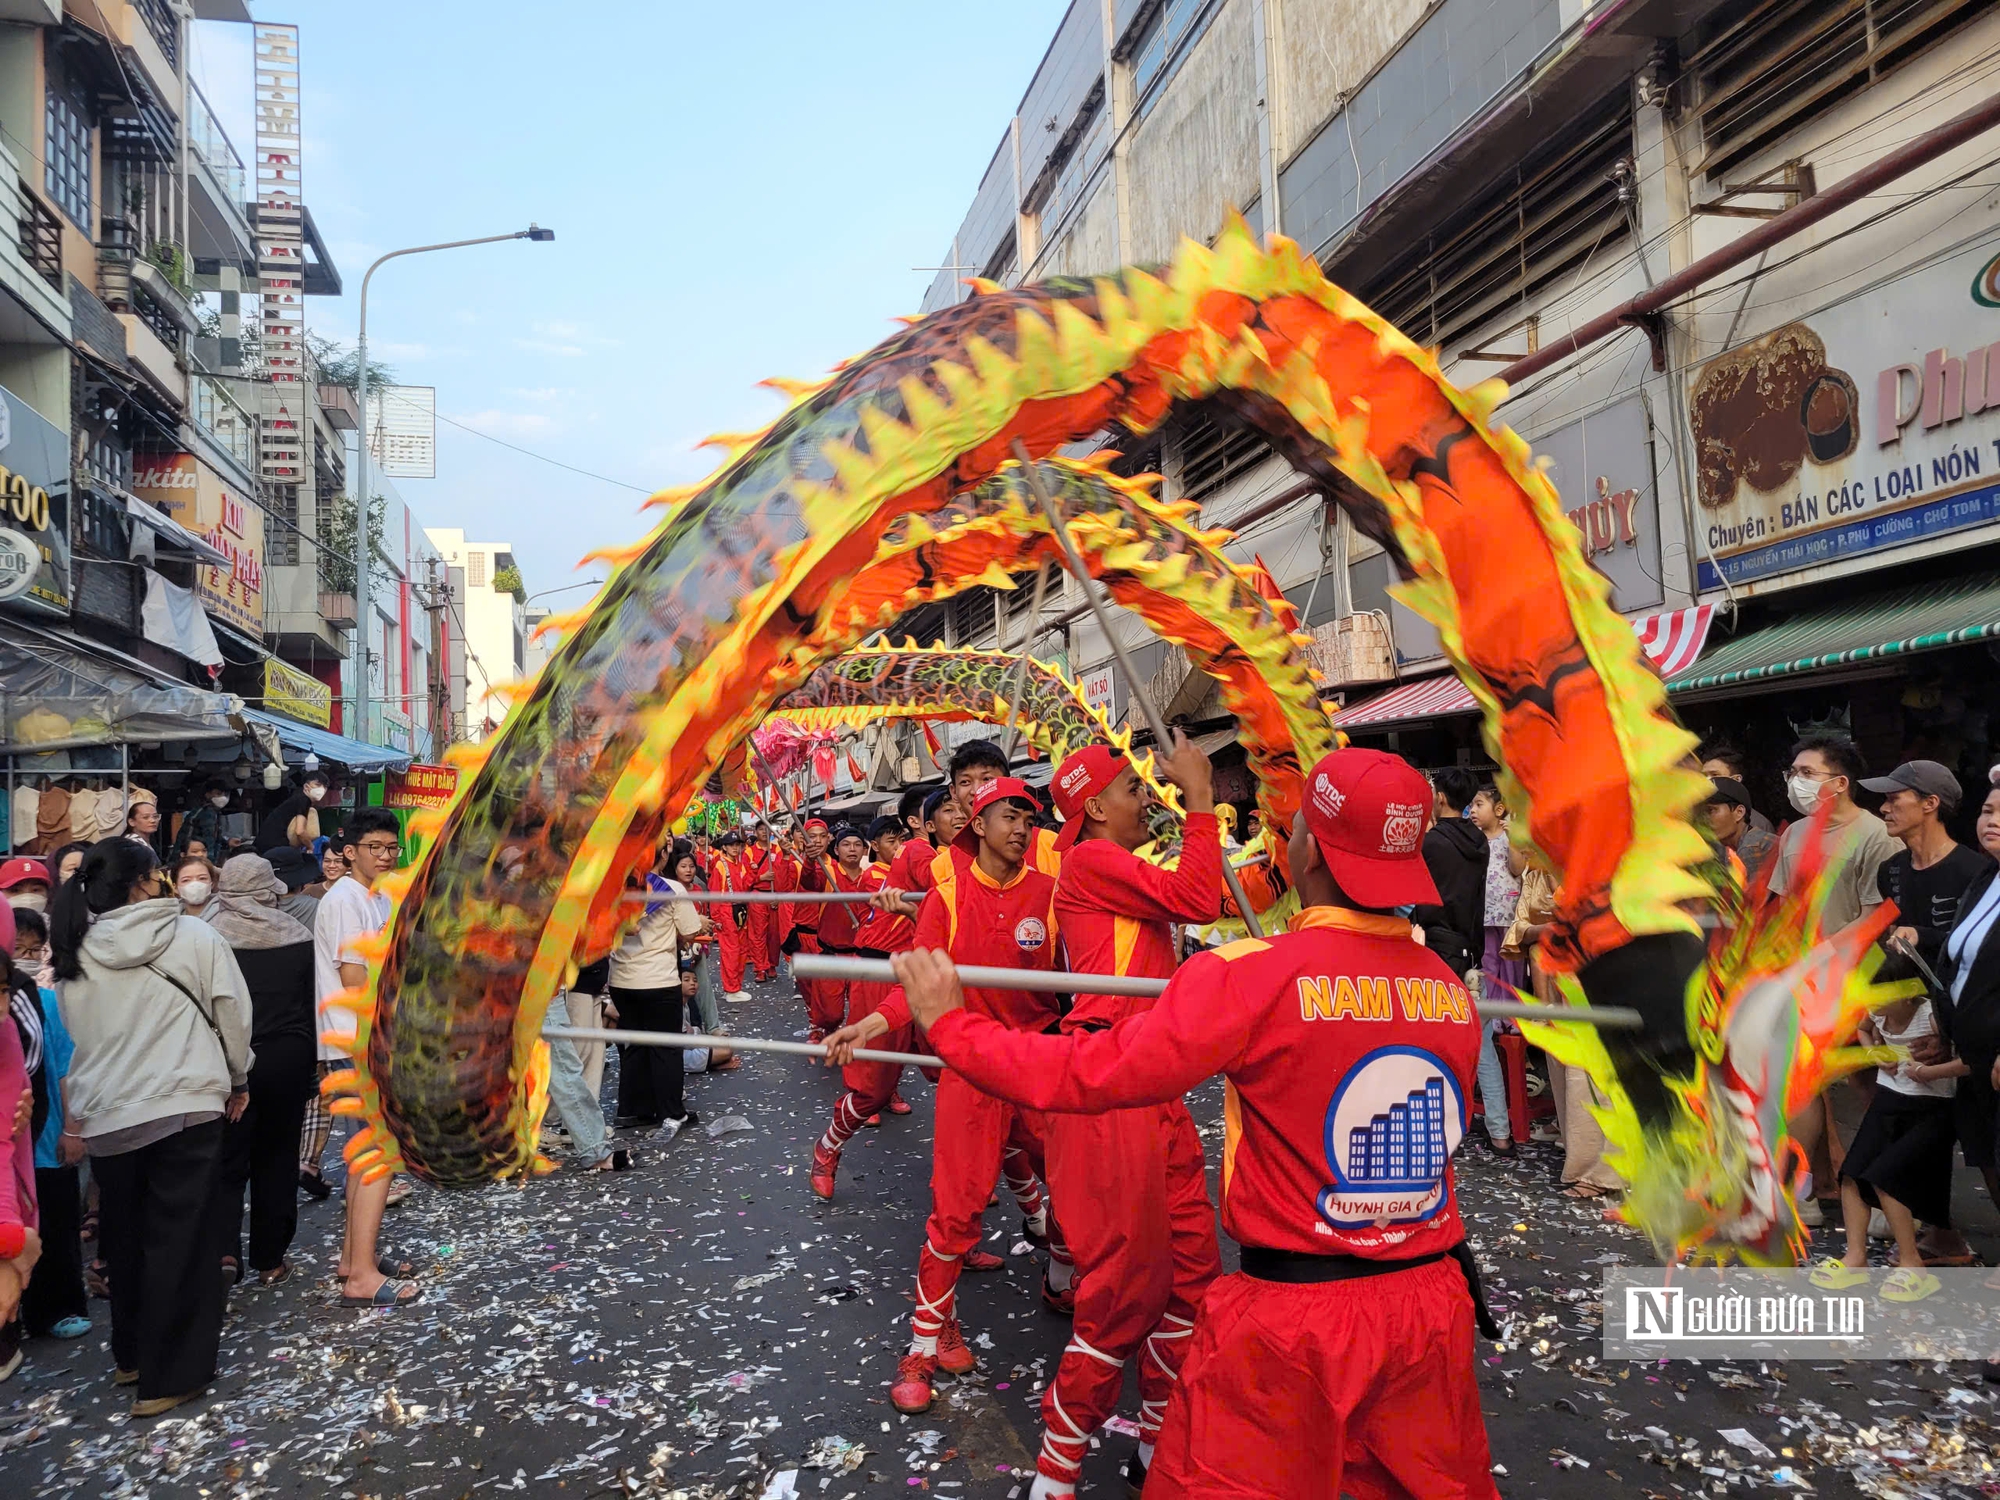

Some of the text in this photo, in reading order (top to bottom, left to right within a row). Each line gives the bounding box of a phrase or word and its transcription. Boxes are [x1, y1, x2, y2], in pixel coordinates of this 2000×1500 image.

[132, 467, 197, 489] akita
[1708, 517, 1766, 550] Chuyên
[1781, 491, 1819, 529] BÁN
[1827, 479, 1865, 516] CÁC
[1874, 463, 1923, 500] LOẠI
[1932, 443, 1980, 486] NÓN
[1781, 543, 1804, 560] THÁI
[1806, 537, 1828, 555] HỌC
[1951, 498, 1981, 517] TDM
[1298, 976, 1393, 1022] NAM
[1388, 1200, 1412, 1214] GIA
